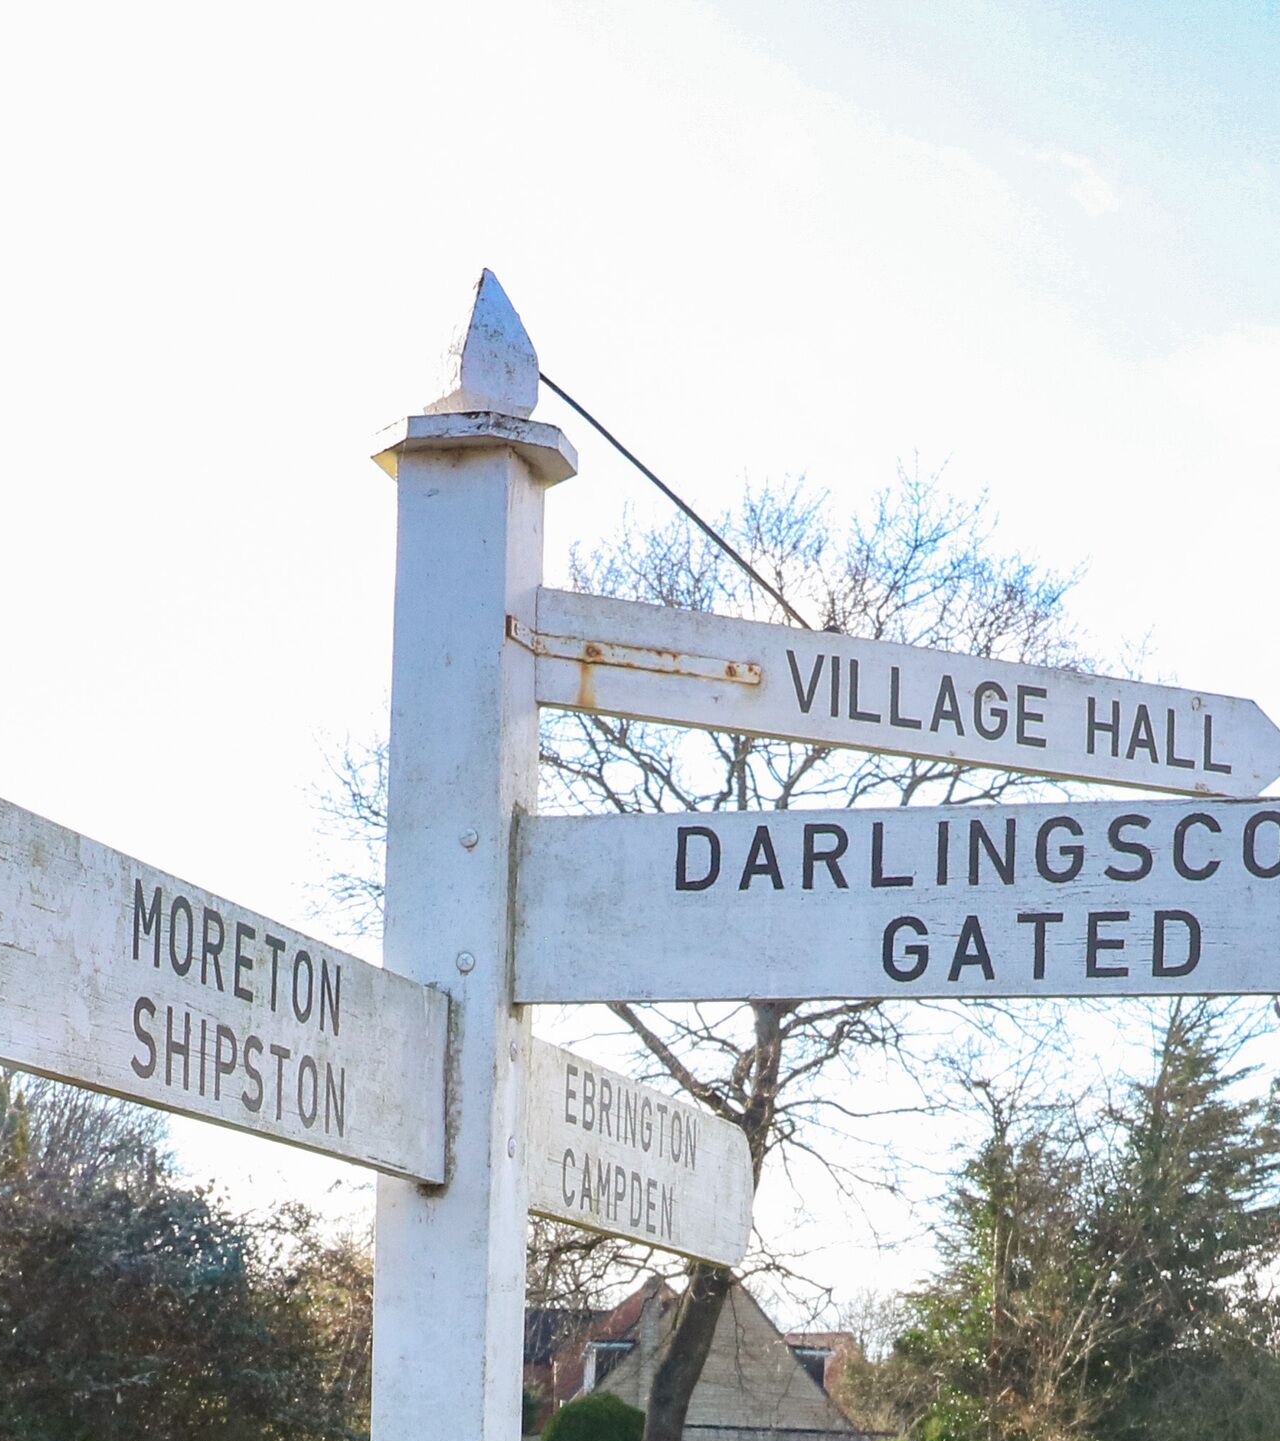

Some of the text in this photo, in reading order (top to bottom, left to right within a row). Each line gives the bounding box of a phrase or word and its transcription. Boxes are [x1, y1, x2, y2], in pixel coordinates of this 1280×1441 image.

[786, 649, 1232, 774] VILLAGE HALL
[132, 878, 342, 1036] MORETON
[882, 909, 1201, 982] GATED
[131, 997, 346, 1138] SHIPSTON
[565, 1063, 697, 1171] EBRINGTON
[562, 1148, 673, 1240] CAMPDEN
